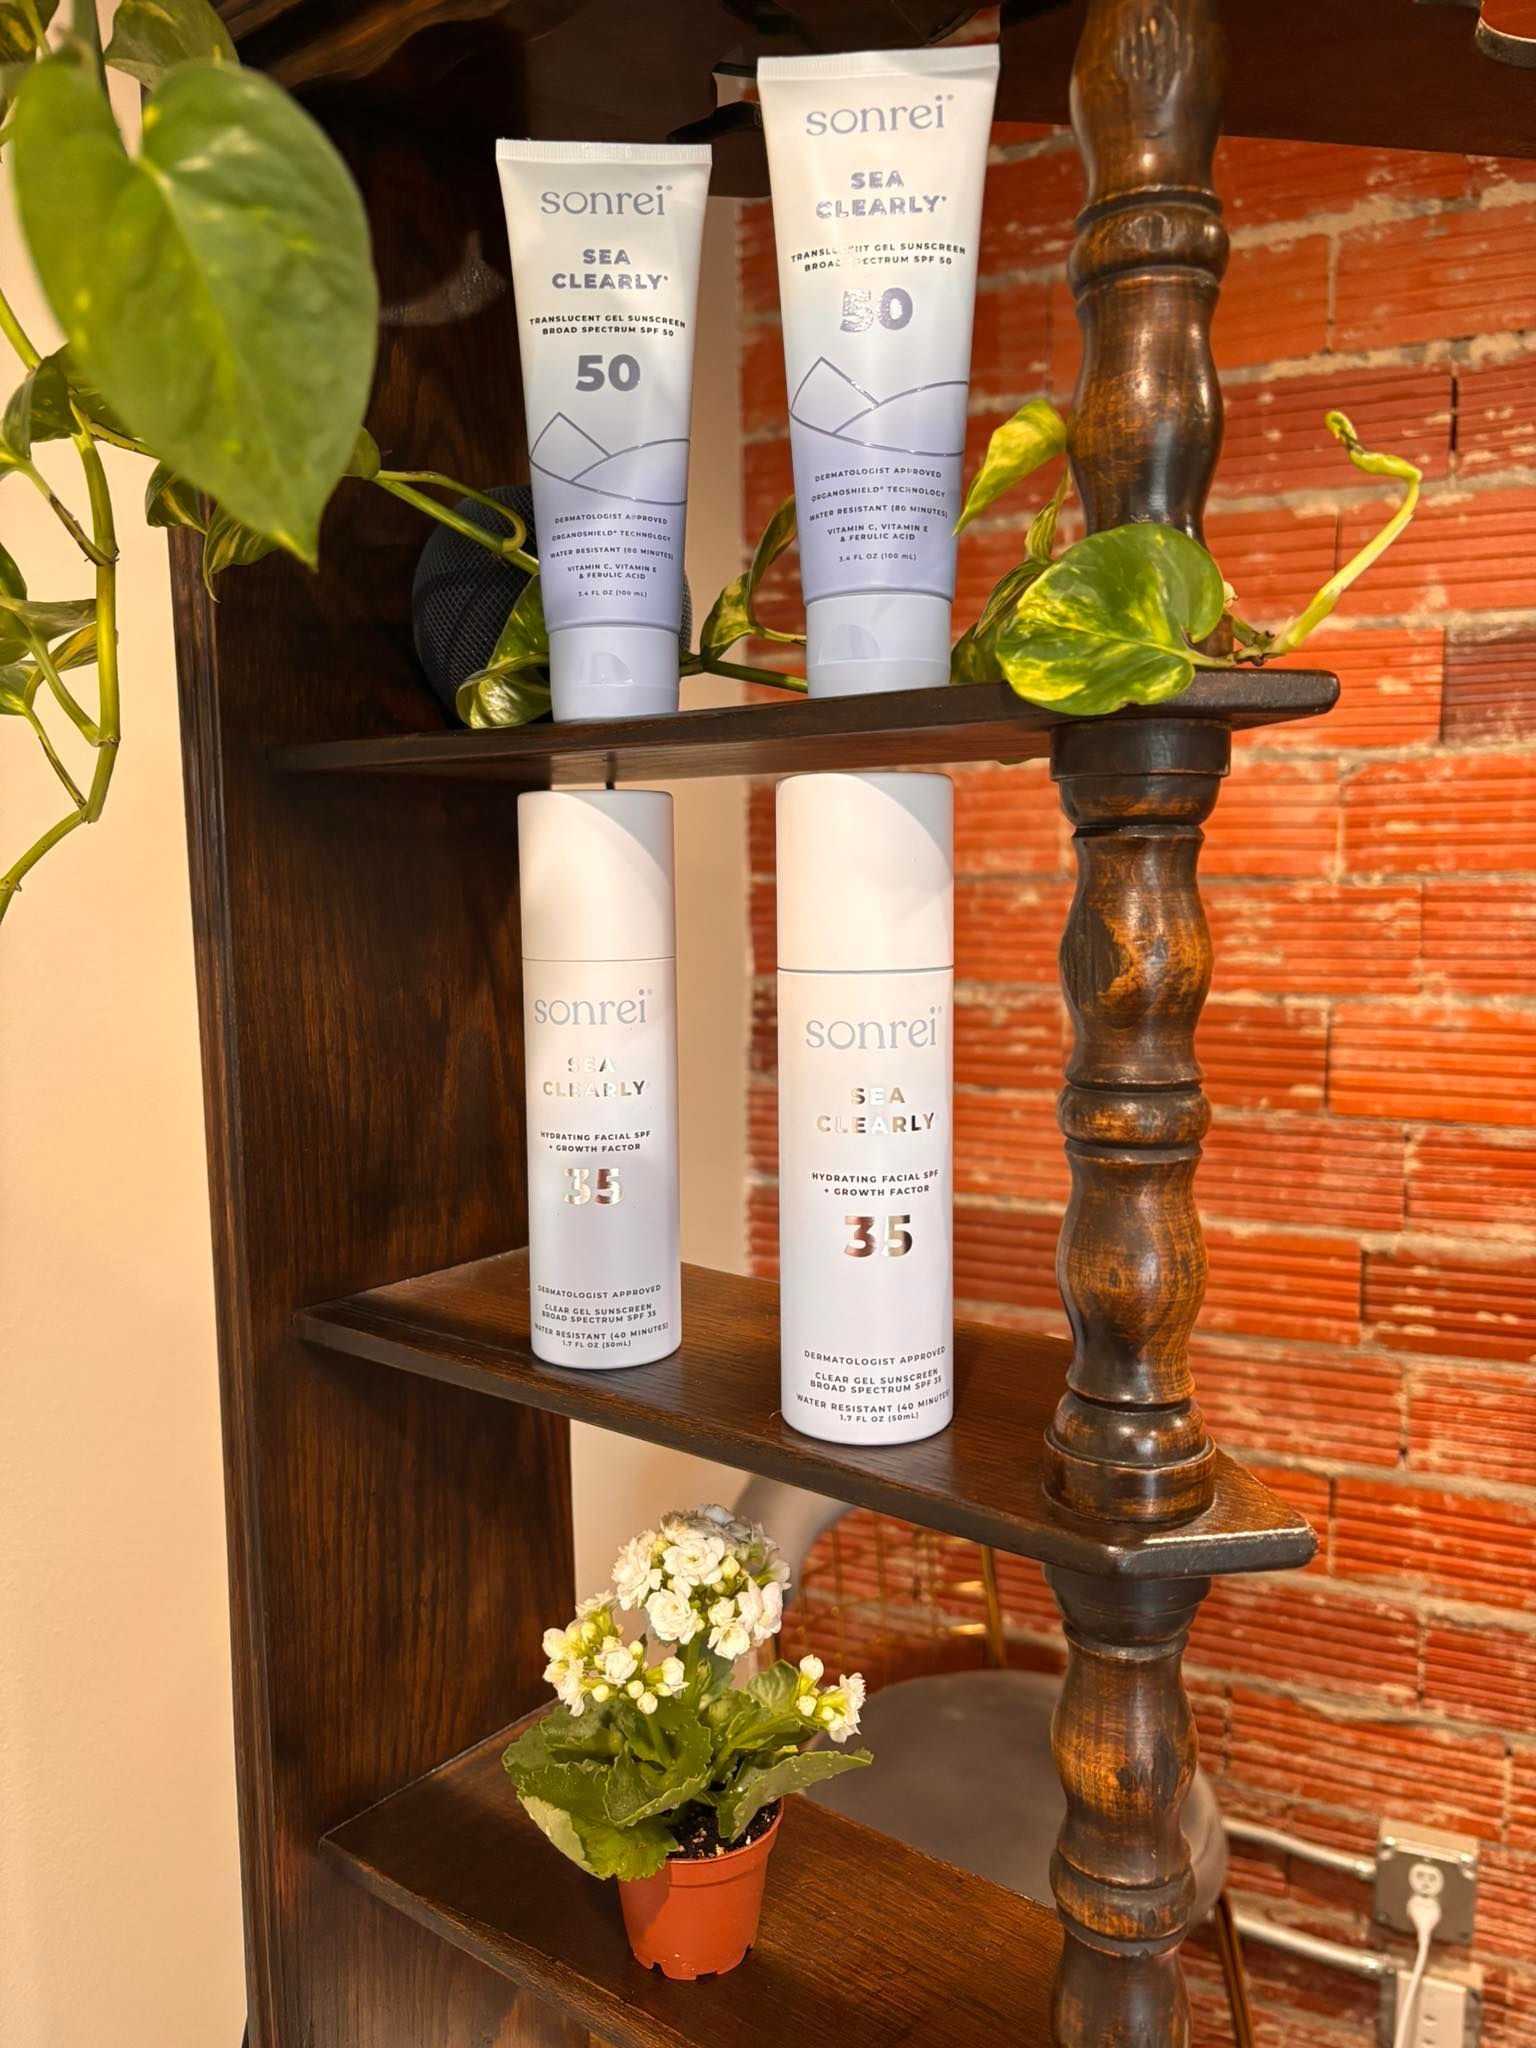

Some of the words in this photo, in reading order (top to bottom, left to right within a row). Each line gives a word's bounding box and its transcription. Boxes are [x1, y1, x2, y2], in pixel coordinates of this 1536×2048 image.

[851, 170, 904, 189] SEA
[900, 242, 966, 255] SUNSCREEN
[583, 249, 631, 265] SEA
[853, 256, 908, 265] ECTRUM
[914, 255, 934, 263] SPF
[840, 287, 913, 333] 50
[530, 315, 600, 325] TRANSLUCENT
[628, 315, 686, 328] SUNSCREEN
[542, 326, 577, 335] BROAD
[575, 354, 640, 392] 50
[815, 468, 889, 482] DERMATOLOGIST
[894, 468, 942, 478] APPROVED
[888, 486, 945, 498] TECHNOLOGY
[555, 514, 622, 524] DERMATOLOGIST
[626, 514, 668, 525] APPROVED
[809, 510, 834, 521] WATER
[837, 505, 887, 514] RESISTANT
[910, 506, 948, 519] MINUTES)
[827, 525, 864, 535] VITAMIN
[881, 524, 920, 532] VITAMIN
[620, 531, 671, 542] TECHNOLOGY
[550, 549, 572, 559] WATER
[640, 549, 673, 560] MINUTES)
[568, 564, 600, 572] VITAMIN
[616, 564, 649, 572] VITAMIN
[851, 1087, 905, 1105] SEA
[817, 1113, 934, 1134] CLEARLY
[541, 1131, 590, 1141] HYDRATING
[595, 1133, 630, 1141] FACIAL
[602, 1144, 640, 1152] FACTOR
[812, 1172, 877, 1183] HYDRATING
[882, 1172, 920, 1183] FACIAL
[924, 1170, 939, 1179] SPF
[563, 1168, 623, 1205] 35
[834, 1187, 884, 1196] GROWTH
[890, 1185, 929, 1196] FACTOR
[844, 1214, 913, 1257] 35
[538, 1285, 608, 1299] DERMATOLOGIST
[612, 1284, 661, 1298] APPROVED
[545, 1304, 569, 1314] CLEAR
[595, 1303, 652, 1315] SUNSCREEN
[542, 1311, 567, 1322] BROAD
[571, 1316, 623, 1324] SPECTRUM
[627, 1313, 644, 1321] SPF
[534, 1323, 553, 1335] WATER
[556, 1330, 606, 1340] RESISTANT
[611, 1332, 626, 1340] (40
[631, 1322, 668, 1337] MINUTES)
[602, 1340, 631, 1348] (50mL)
[804, 1350, 895, 1366] DERMATOLOGIST
[900, 1346, 945, 1364] APPROVED
[815, 1372, 848, 1384] CLEAR
[854, 1377, 875, 1385] GEL
[881, 1368, 938, 1384] SUNSCREEN
[810, 1380, 846, 1393] BROAD
[851, 1385, 911, 1394] SPECTRUM
[915, 1380, 931, 1390] SPF
[934, 1375, 942, 1384] 35
[797, 1393, 826, 1408] WATER
[831, 1403, 892, 1413] RESISTANT
[897, 1403, 914, 1412] (40
[872, 1415, 884, 1423] OZ
[889, 1412, 918, 1423] (50mL)
